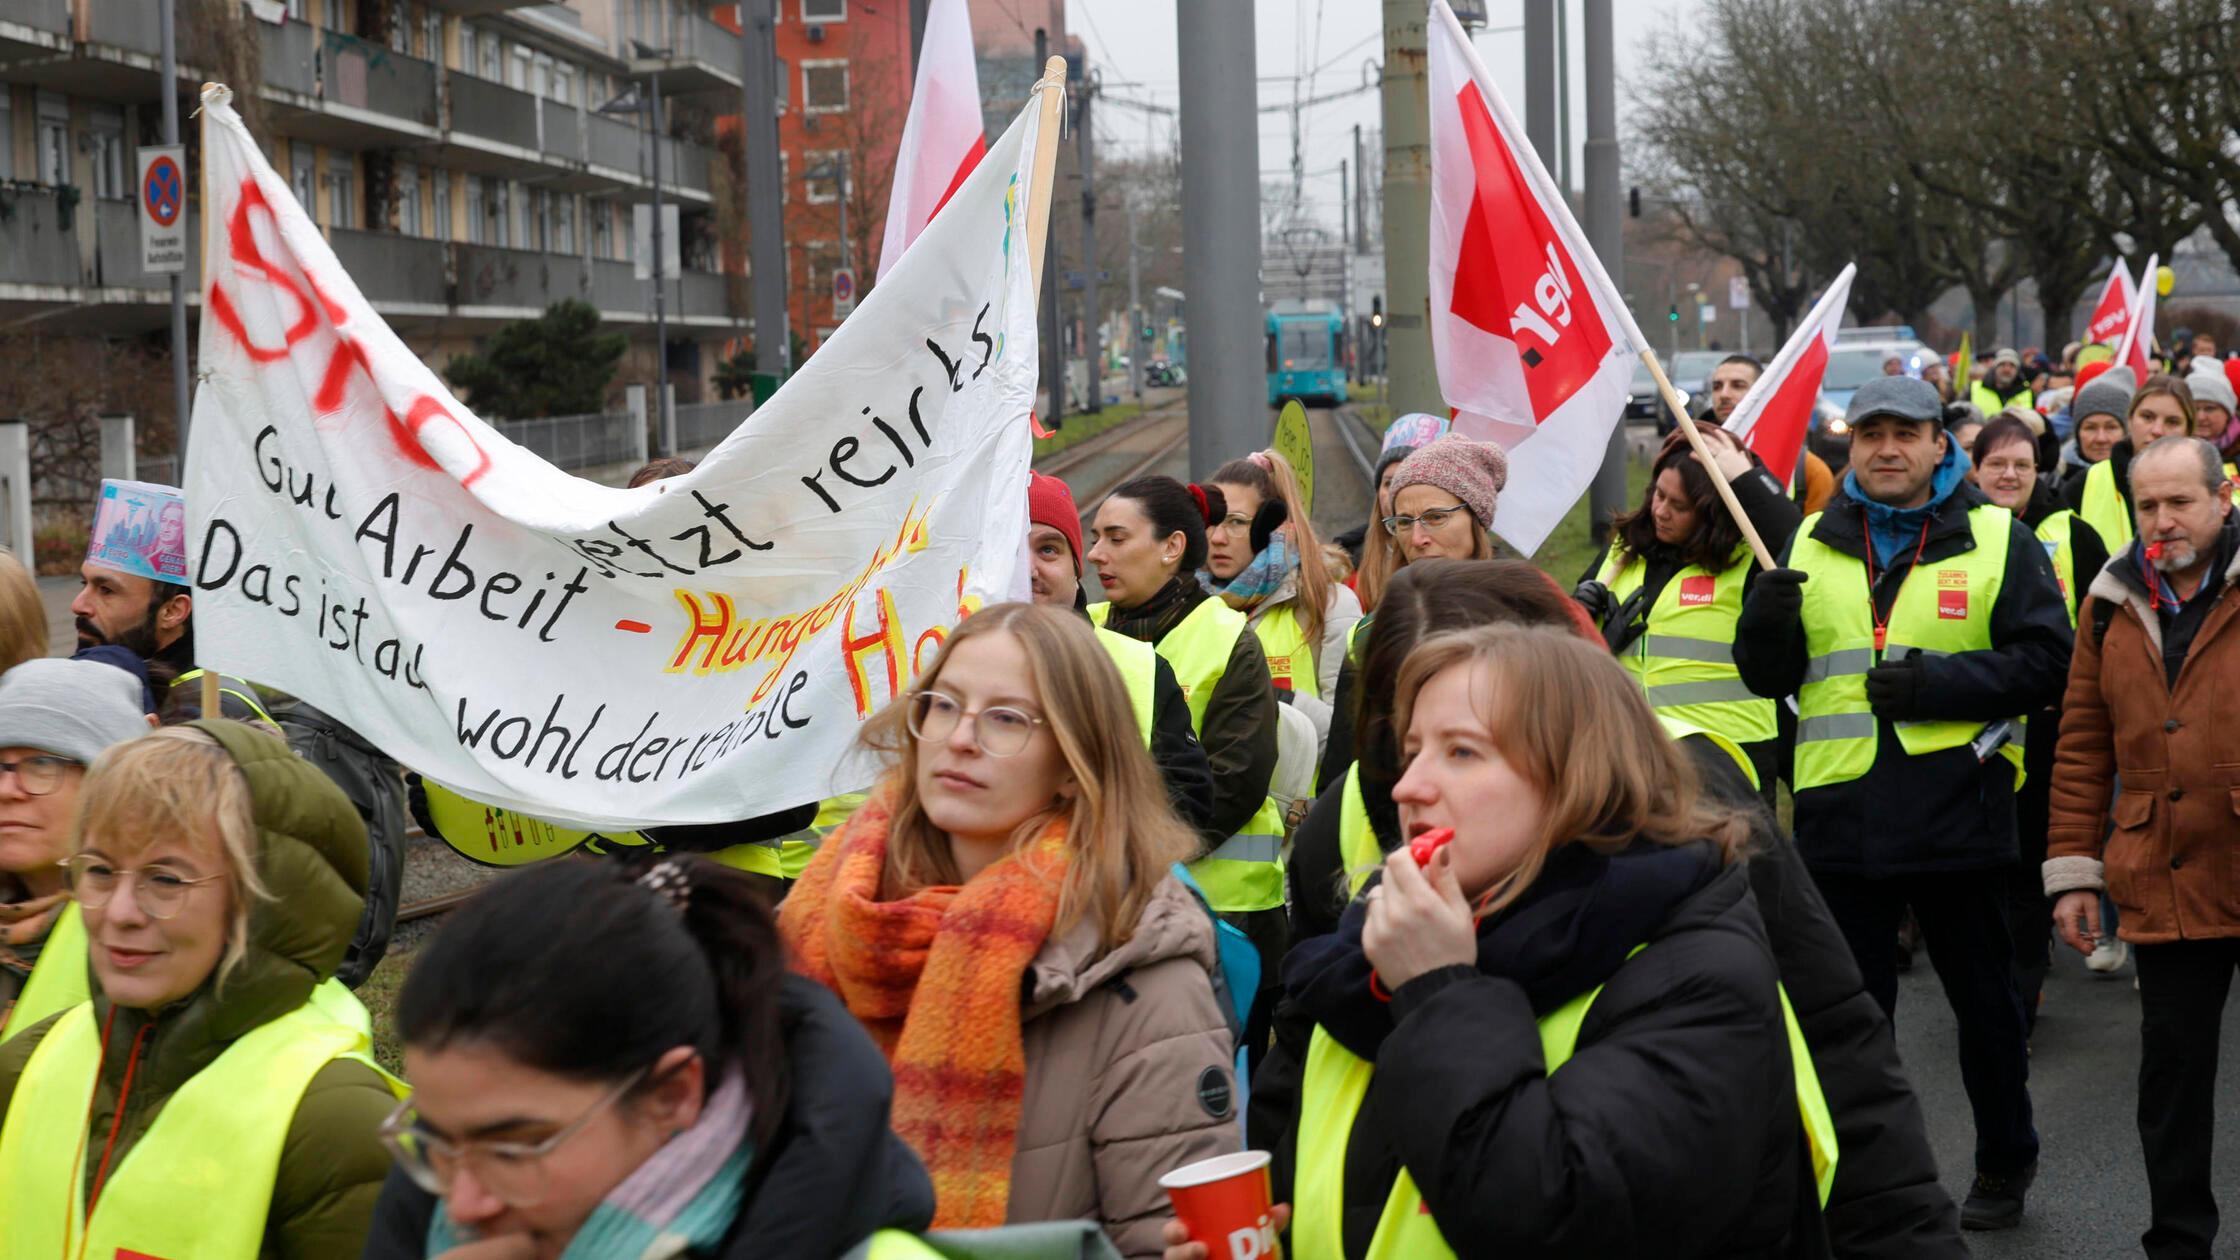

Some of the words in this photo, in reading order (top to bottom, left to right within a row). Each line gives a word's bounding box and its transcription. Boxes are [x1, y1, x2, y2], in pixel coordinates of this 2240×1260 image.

[355, 493, 589, 642] Arbeit
[1681, 593, 1713, 602] ver.di
[197, 519, 300, 616] Das
[317, 578, 369, 665] ist
[457, 694, 606, 780] wohl
[595, 712, 690, 784] der
